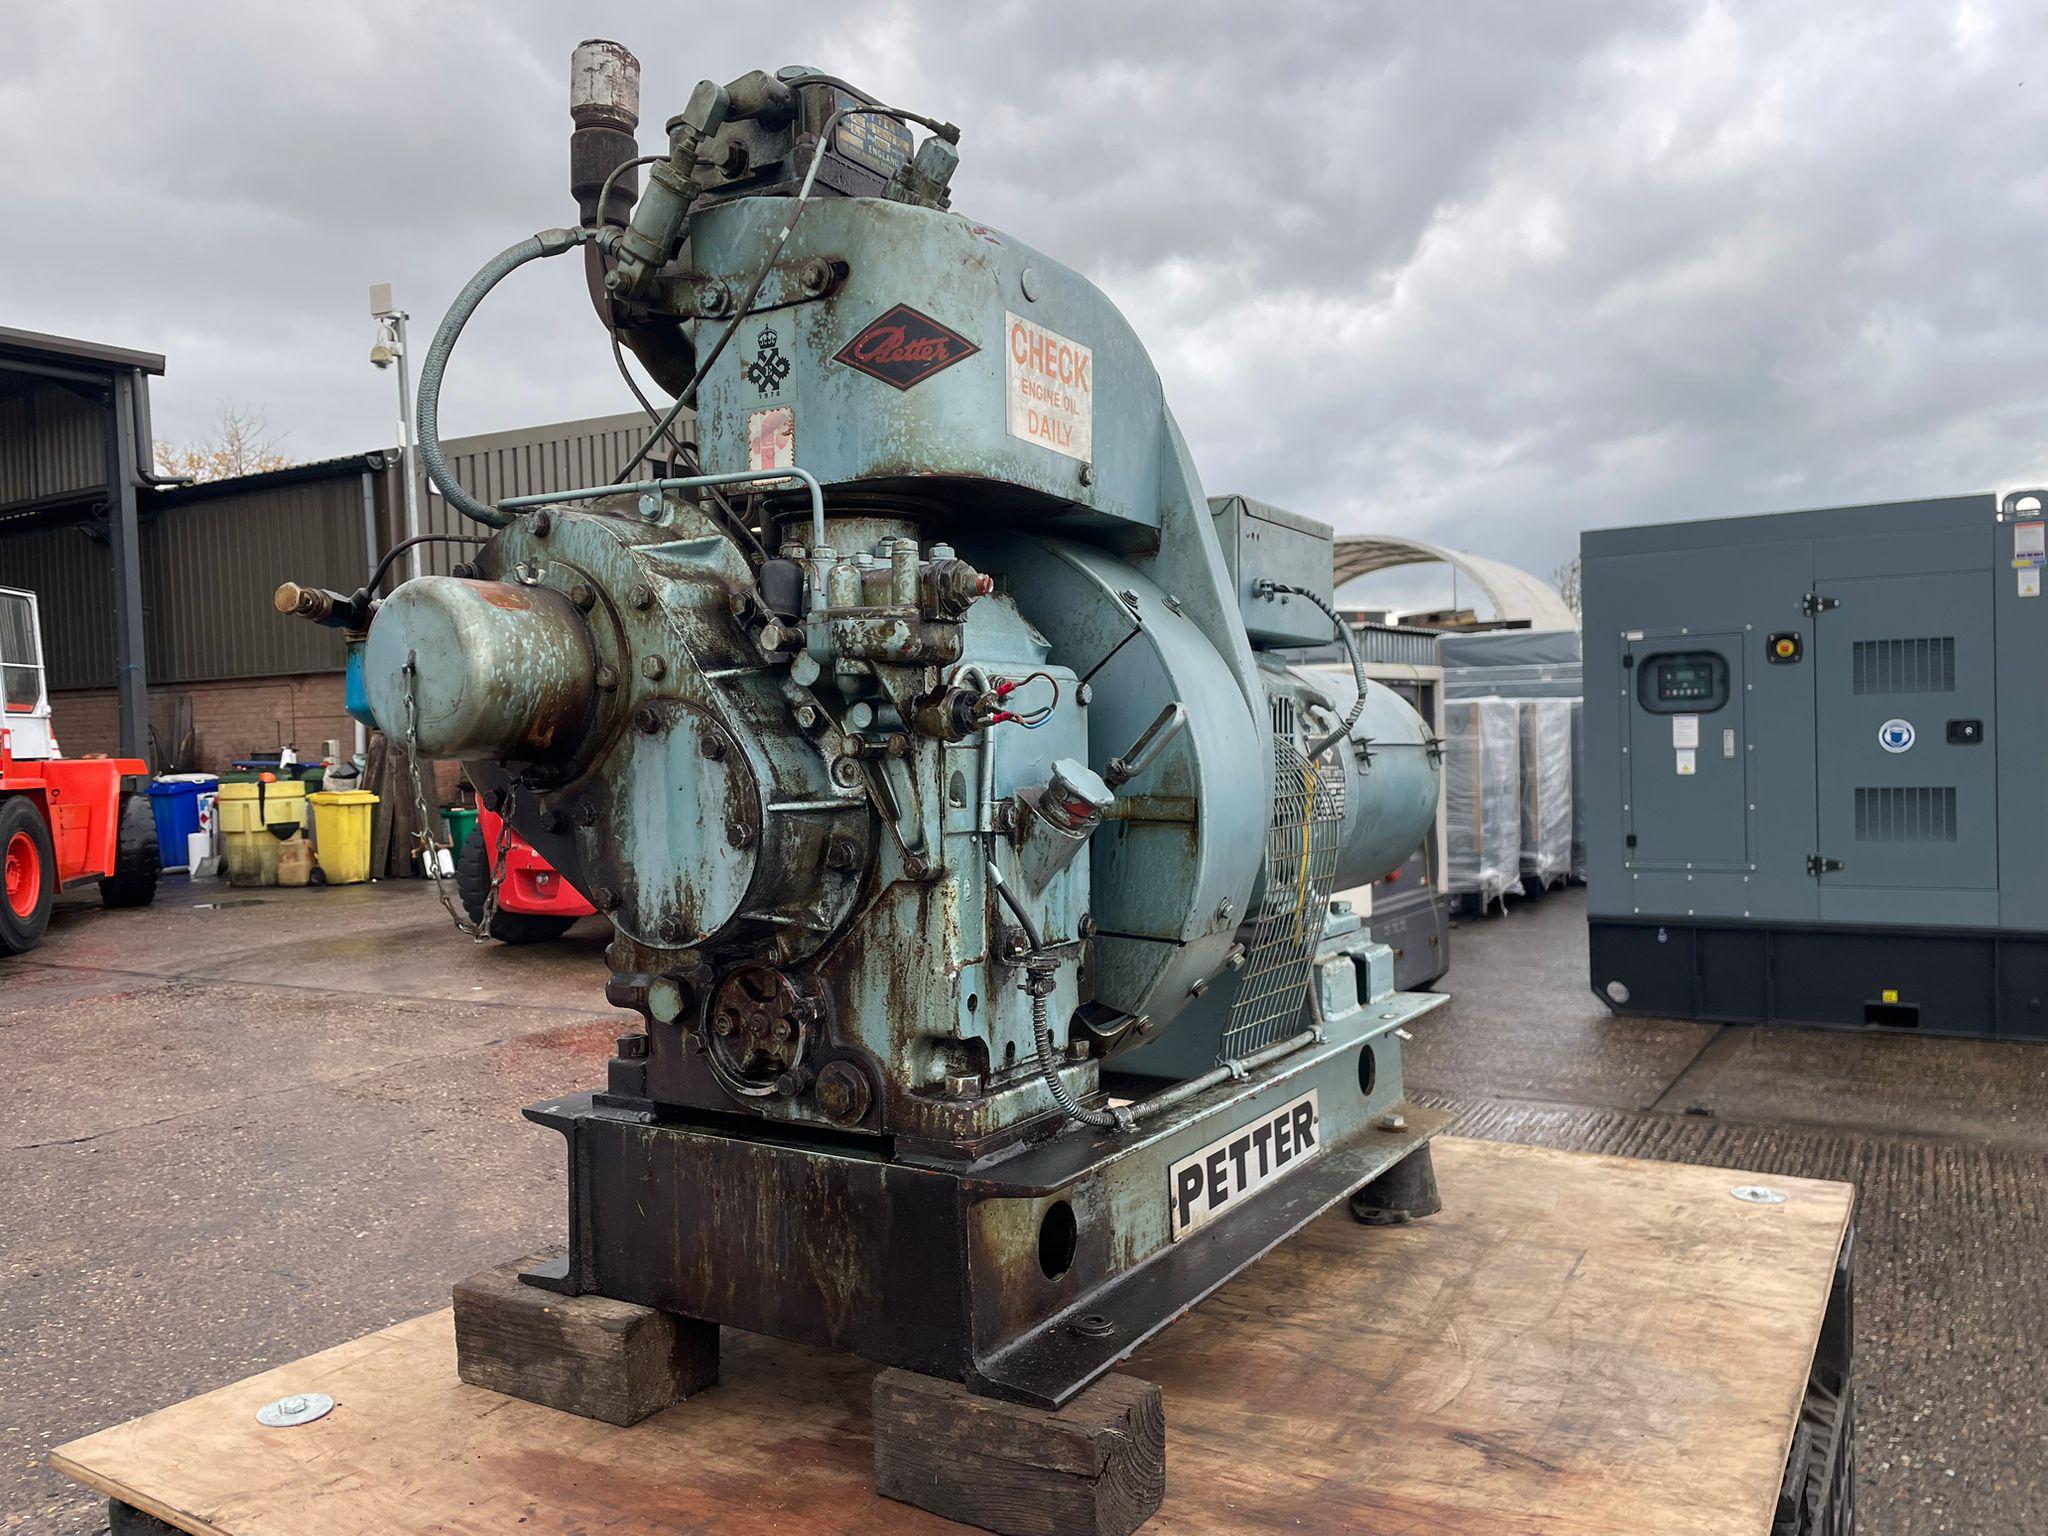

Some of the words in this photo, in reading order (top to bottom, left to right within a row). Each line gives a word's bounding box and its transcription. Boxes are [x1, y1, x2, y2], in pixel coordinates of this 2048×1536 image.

[868, 146, 901, 167] ENGLAND
[853, 324, 951, 364] Petter
[1011, 323, 1089, 392] CHECK
[1021, 378, 1060, 408] ENGINE
[1064, 393, 1080, 415] OIL
[1027, 408, 1073, 448] DAILY
[1177, 1100, 1316, 1228] PETTER
